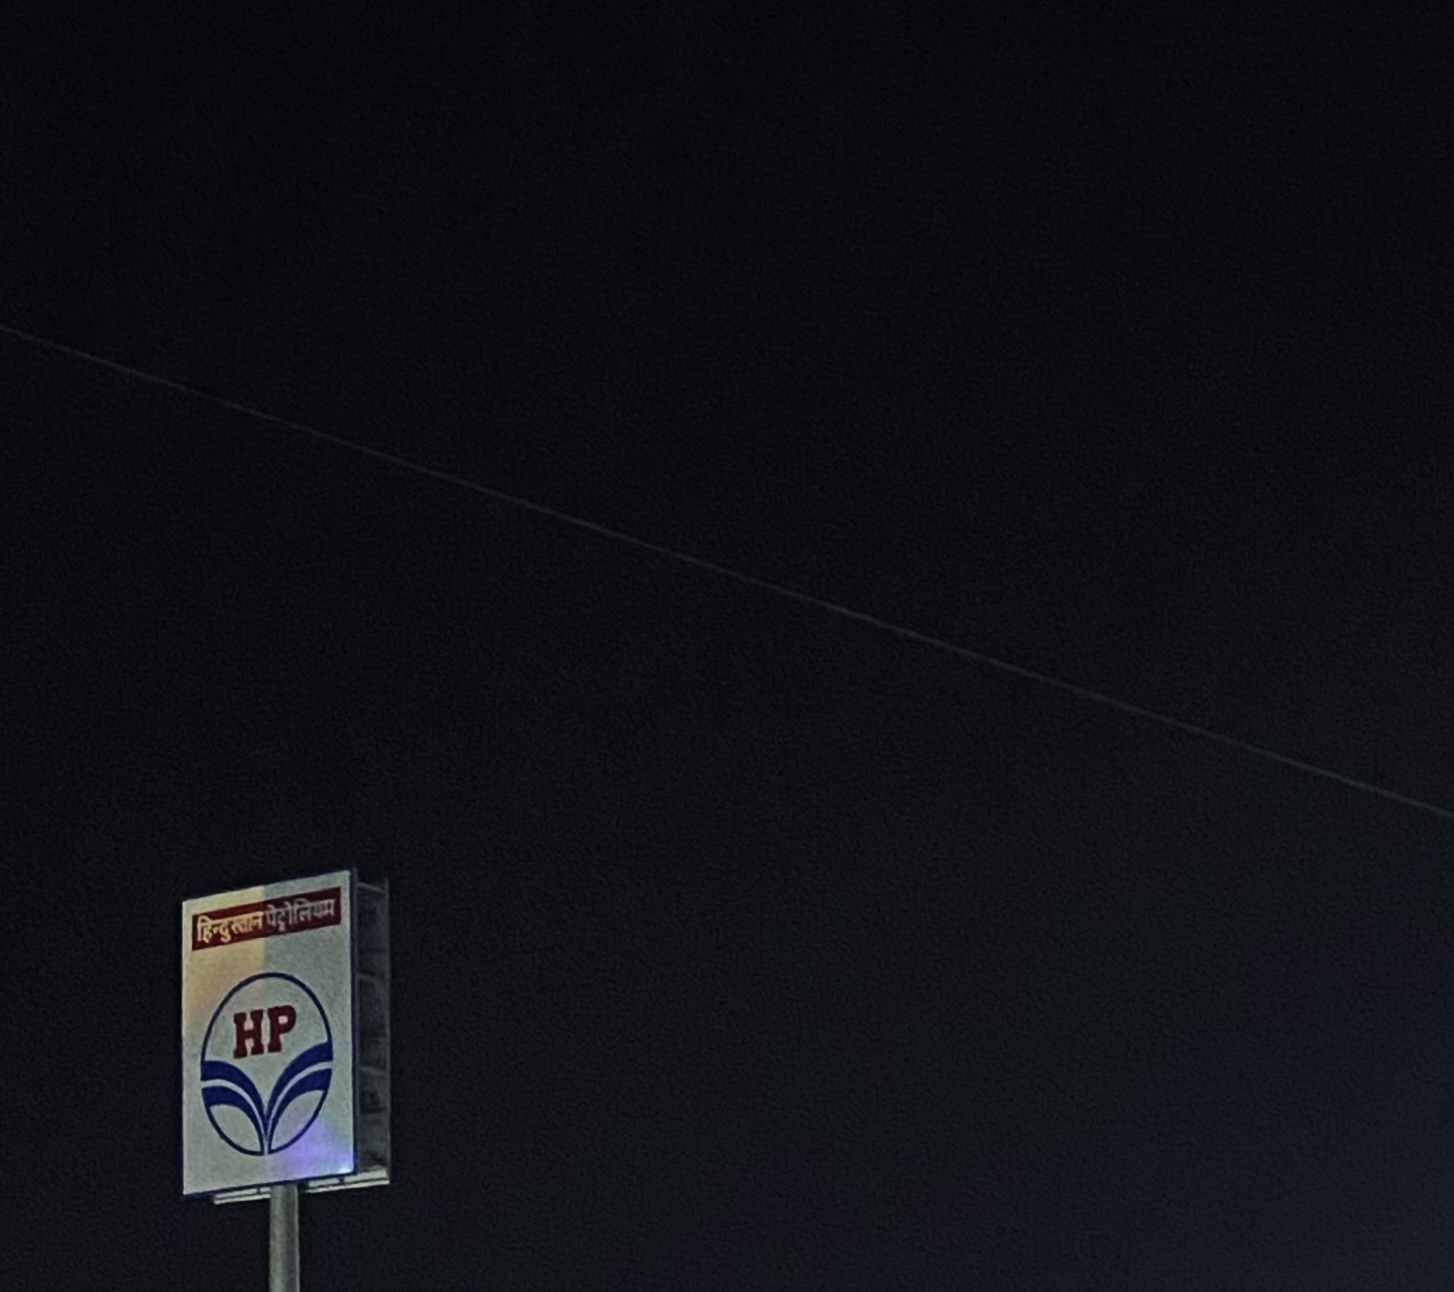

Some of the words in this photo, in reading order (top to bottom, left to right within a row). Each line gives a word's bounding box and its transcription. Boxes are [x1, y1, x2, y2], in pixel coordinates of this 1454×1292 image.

[197, 910, 264, 943] हिन्दुस्तान
[265, 898, 336, 931] पेट्रोलियम
[233, 1004, 297, 1059] HP
